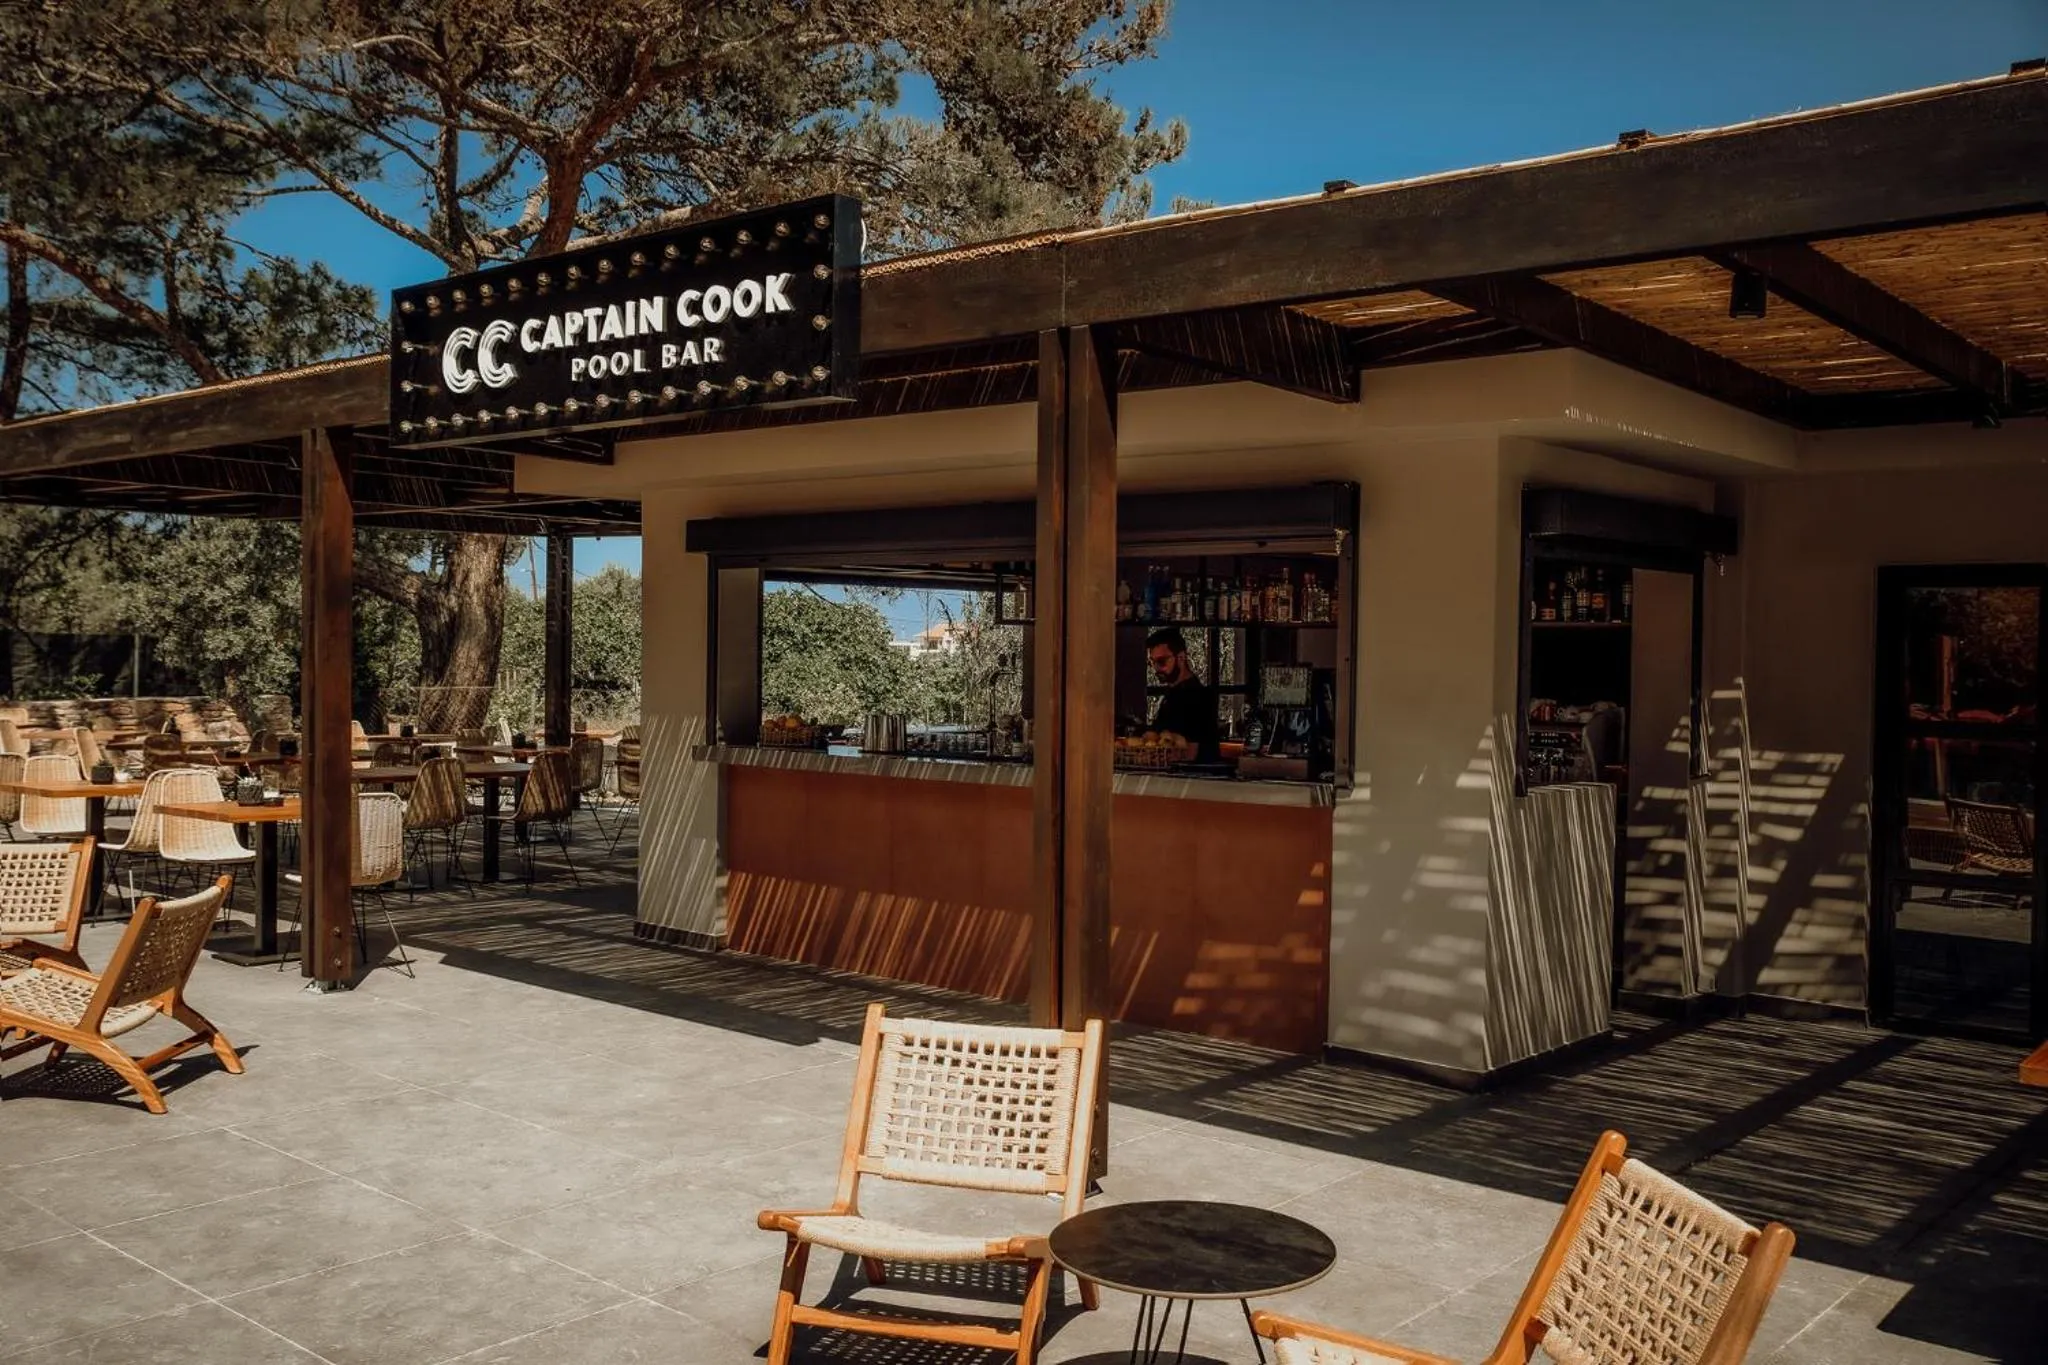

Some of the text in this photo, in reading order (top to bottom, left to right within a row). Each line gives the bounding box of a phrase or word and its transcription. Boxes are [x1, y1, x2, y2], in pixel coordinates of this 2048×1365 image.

[520, 272, 794, 353] CAPTAIN COOK
[442, 319, 518, 395] CC
[571, 337, 724, 381] POOL BAR
